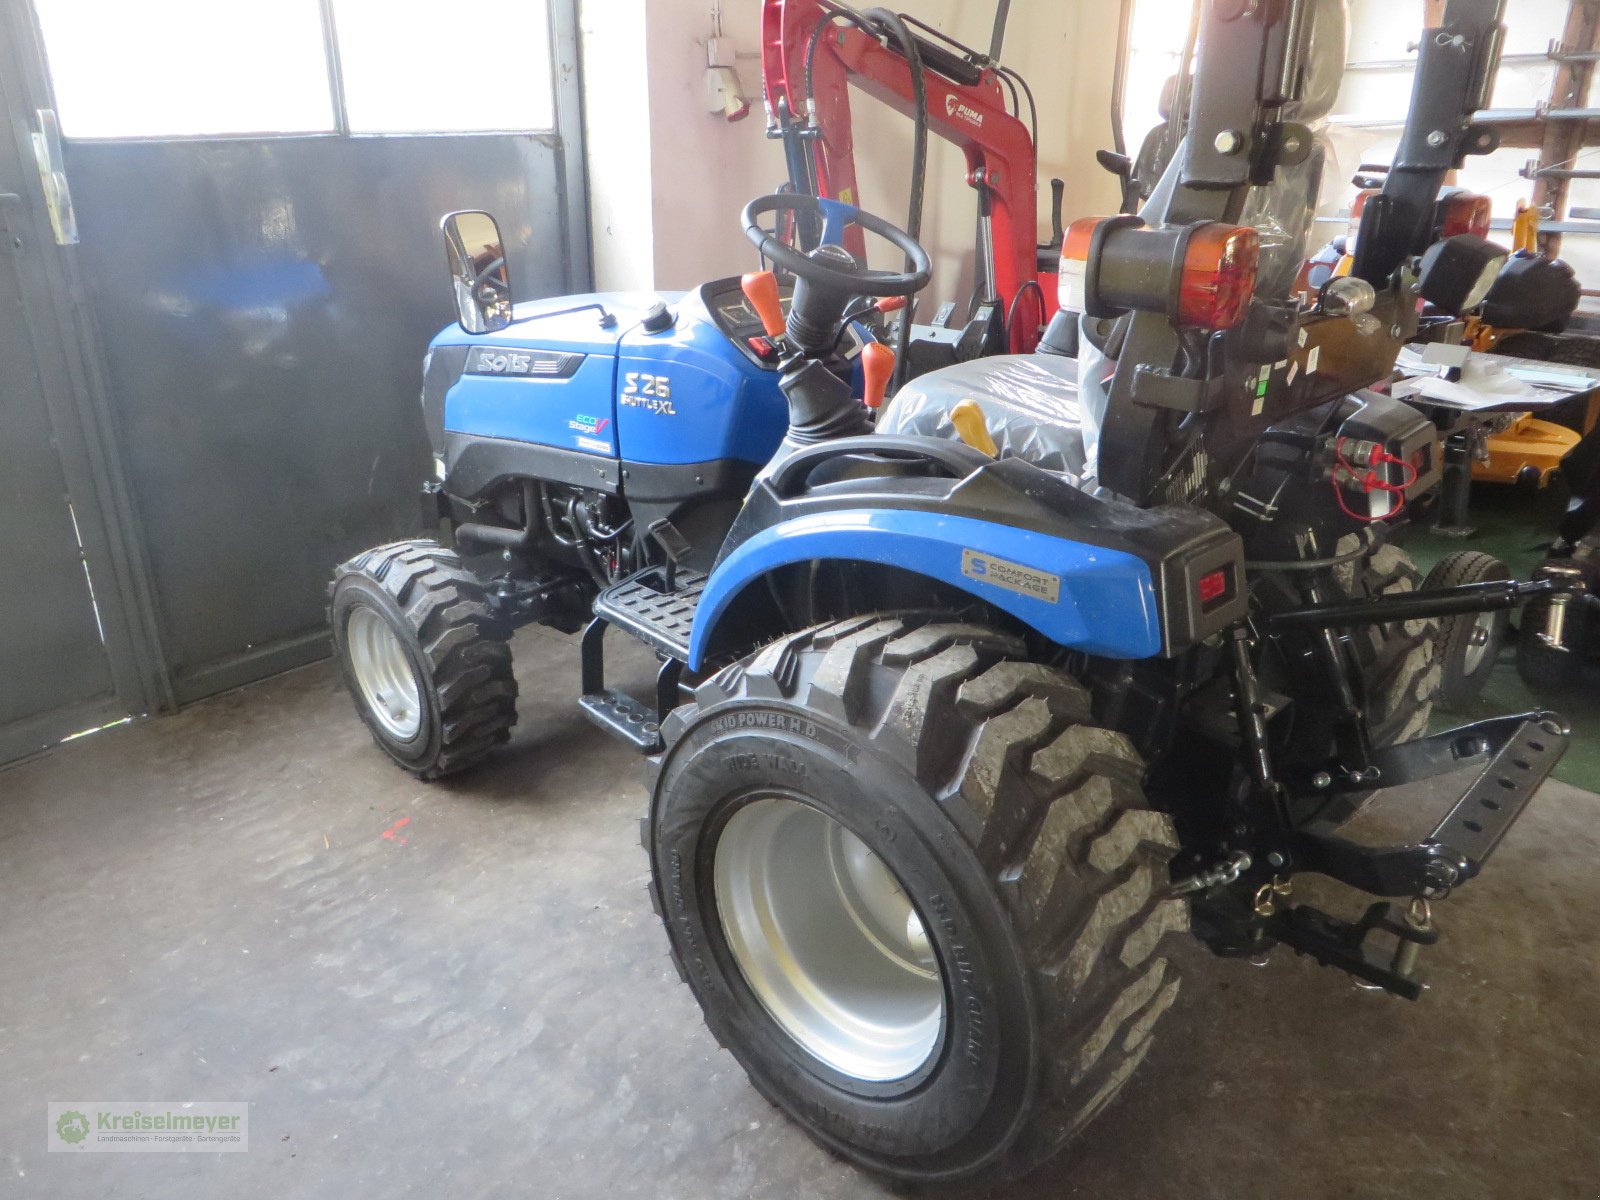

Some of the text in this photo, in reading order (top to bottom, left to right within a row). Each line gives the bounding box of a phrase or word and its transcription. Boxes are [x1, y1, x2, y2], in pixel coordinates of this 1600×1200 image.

[957, 104, 983, 122] PUMA
[624, 372, 671, 398] S 26
[576, 414, 597, 425] ECO
[990, 563, 1049, 586] COMFORT
[990, 571, 1049, 594] PACKAGE
[710, 715, 736, 733] SKID
[738, 712, 785, 730] POWER
